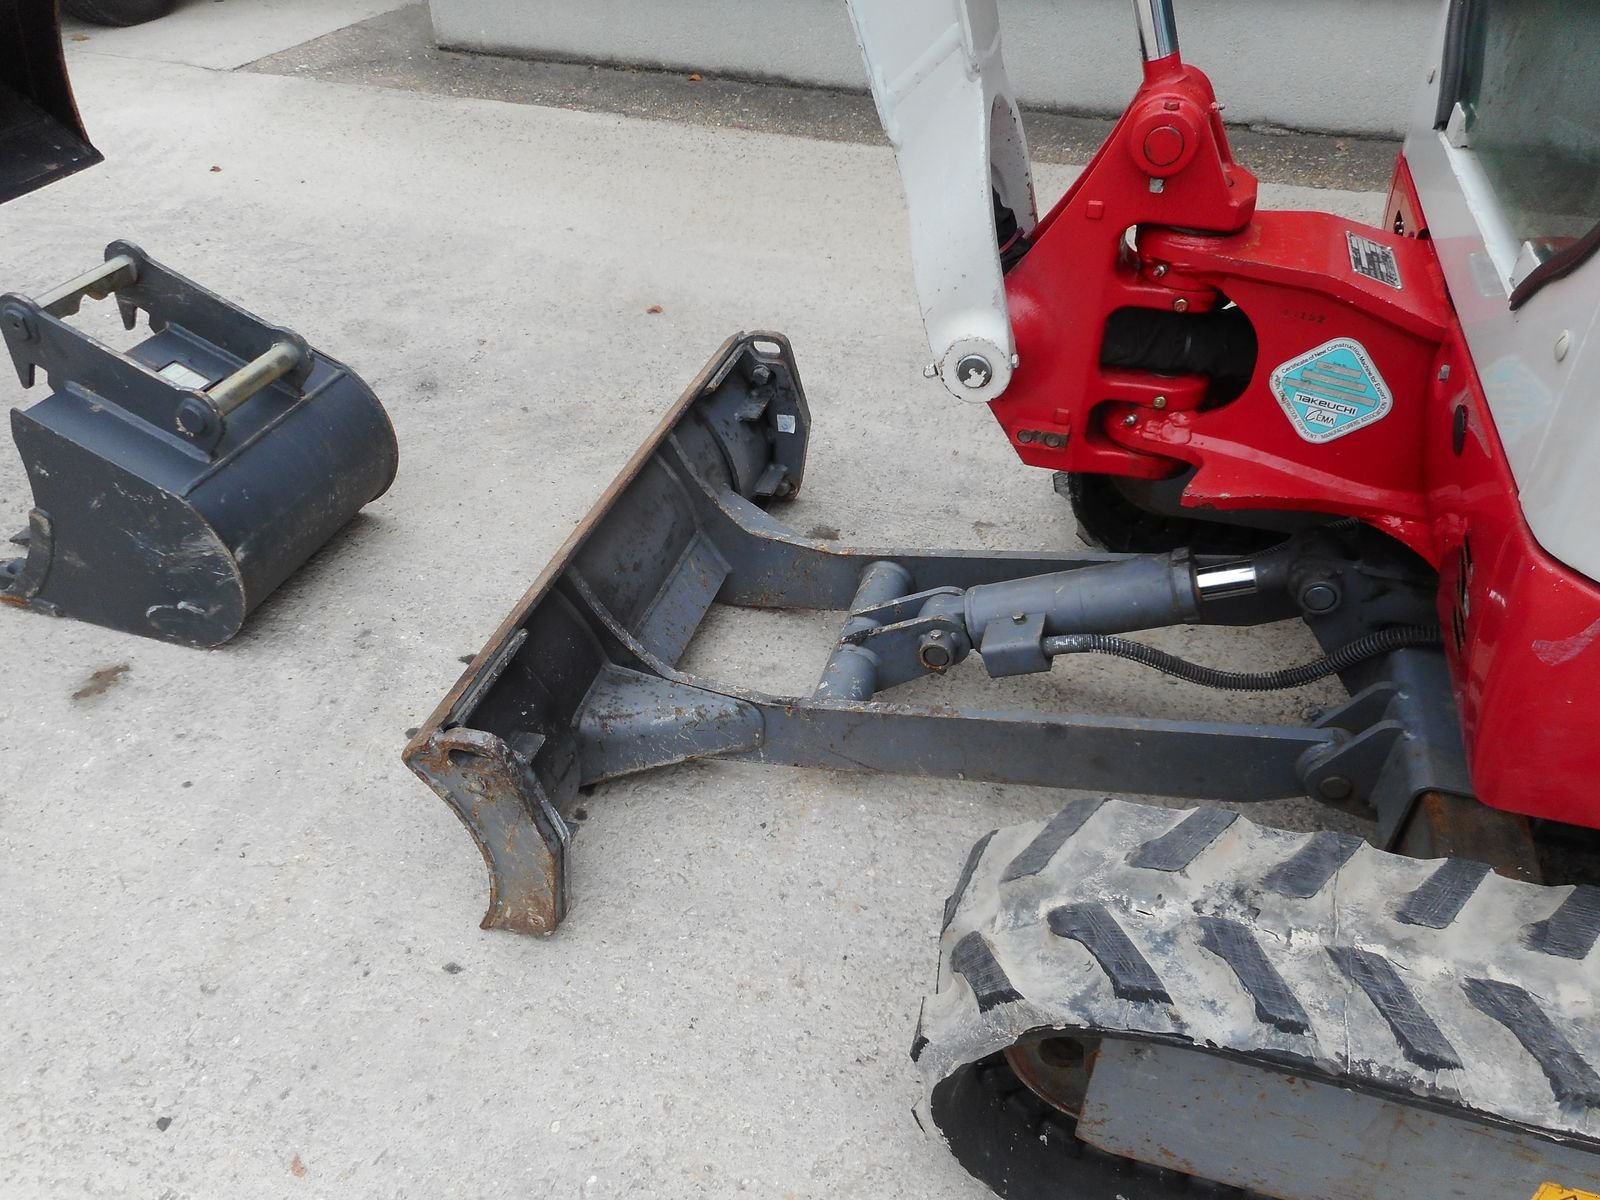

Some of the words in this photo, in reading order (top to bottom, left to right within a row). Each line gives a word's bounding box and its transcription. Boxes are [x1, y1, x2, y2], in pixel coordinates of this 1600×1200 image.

[1282, 358, 1309, 373] Certificate
[1314, 349, 1327, 357] New
[1327, 343, 1361, 358] Construction
[1359, 356, 1373, 378] Machine
[1374, 383, 1387, 400] Export
